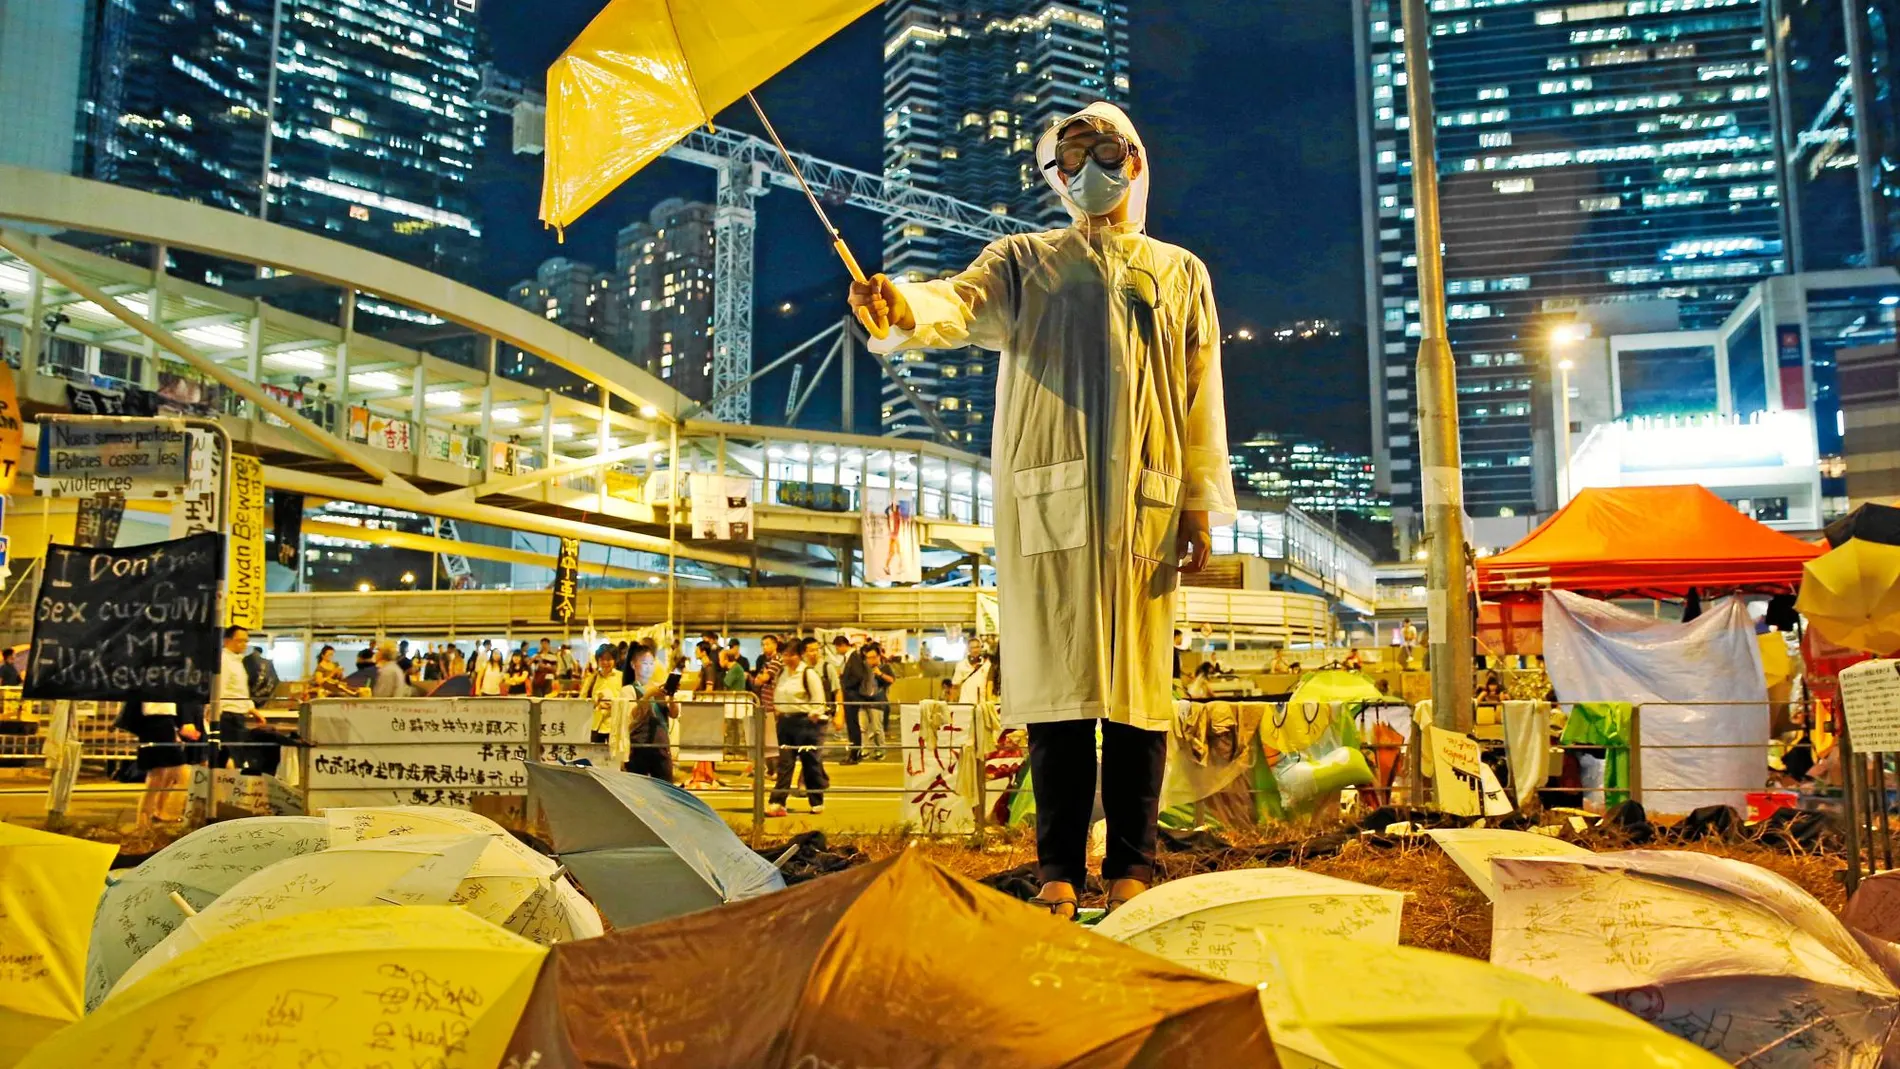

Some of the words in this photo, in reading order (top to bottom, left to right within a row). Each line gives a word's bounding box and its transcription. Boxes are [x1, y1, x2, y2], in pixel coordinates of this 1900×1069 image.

[156, 449, 177, 466] les
[59, 472, 133, 492] violences
[230, 455, 252, 542] Beware!
[230, 544, 252, 624] Taiwan
[126, 629, 184, 657] ME
